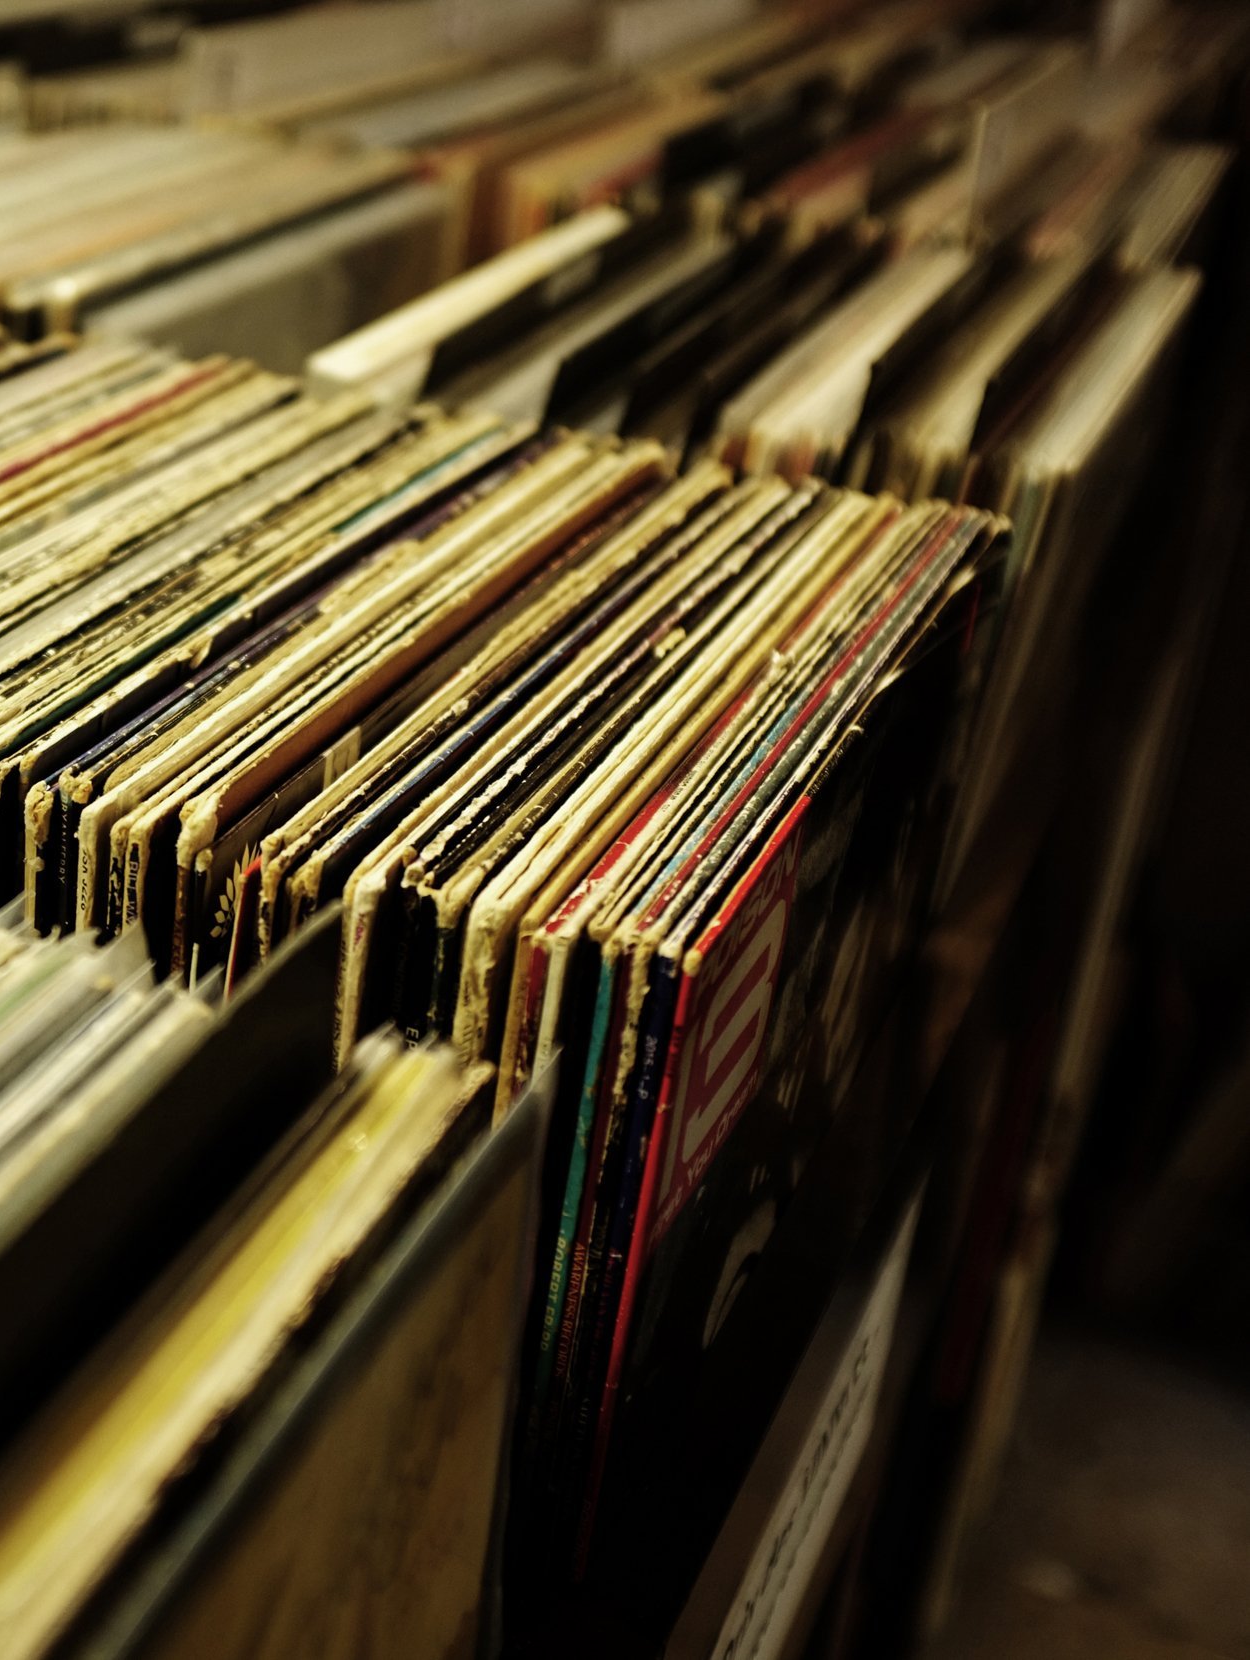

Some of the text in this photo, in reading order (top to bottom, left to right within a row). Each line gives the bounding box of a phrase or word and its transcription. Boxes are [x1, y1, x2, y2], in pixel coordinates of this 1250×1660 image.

[551, 1236, 568, 1304] ROBERT
[553, 1241, 587, 1377] AWARENESS RECORDS
